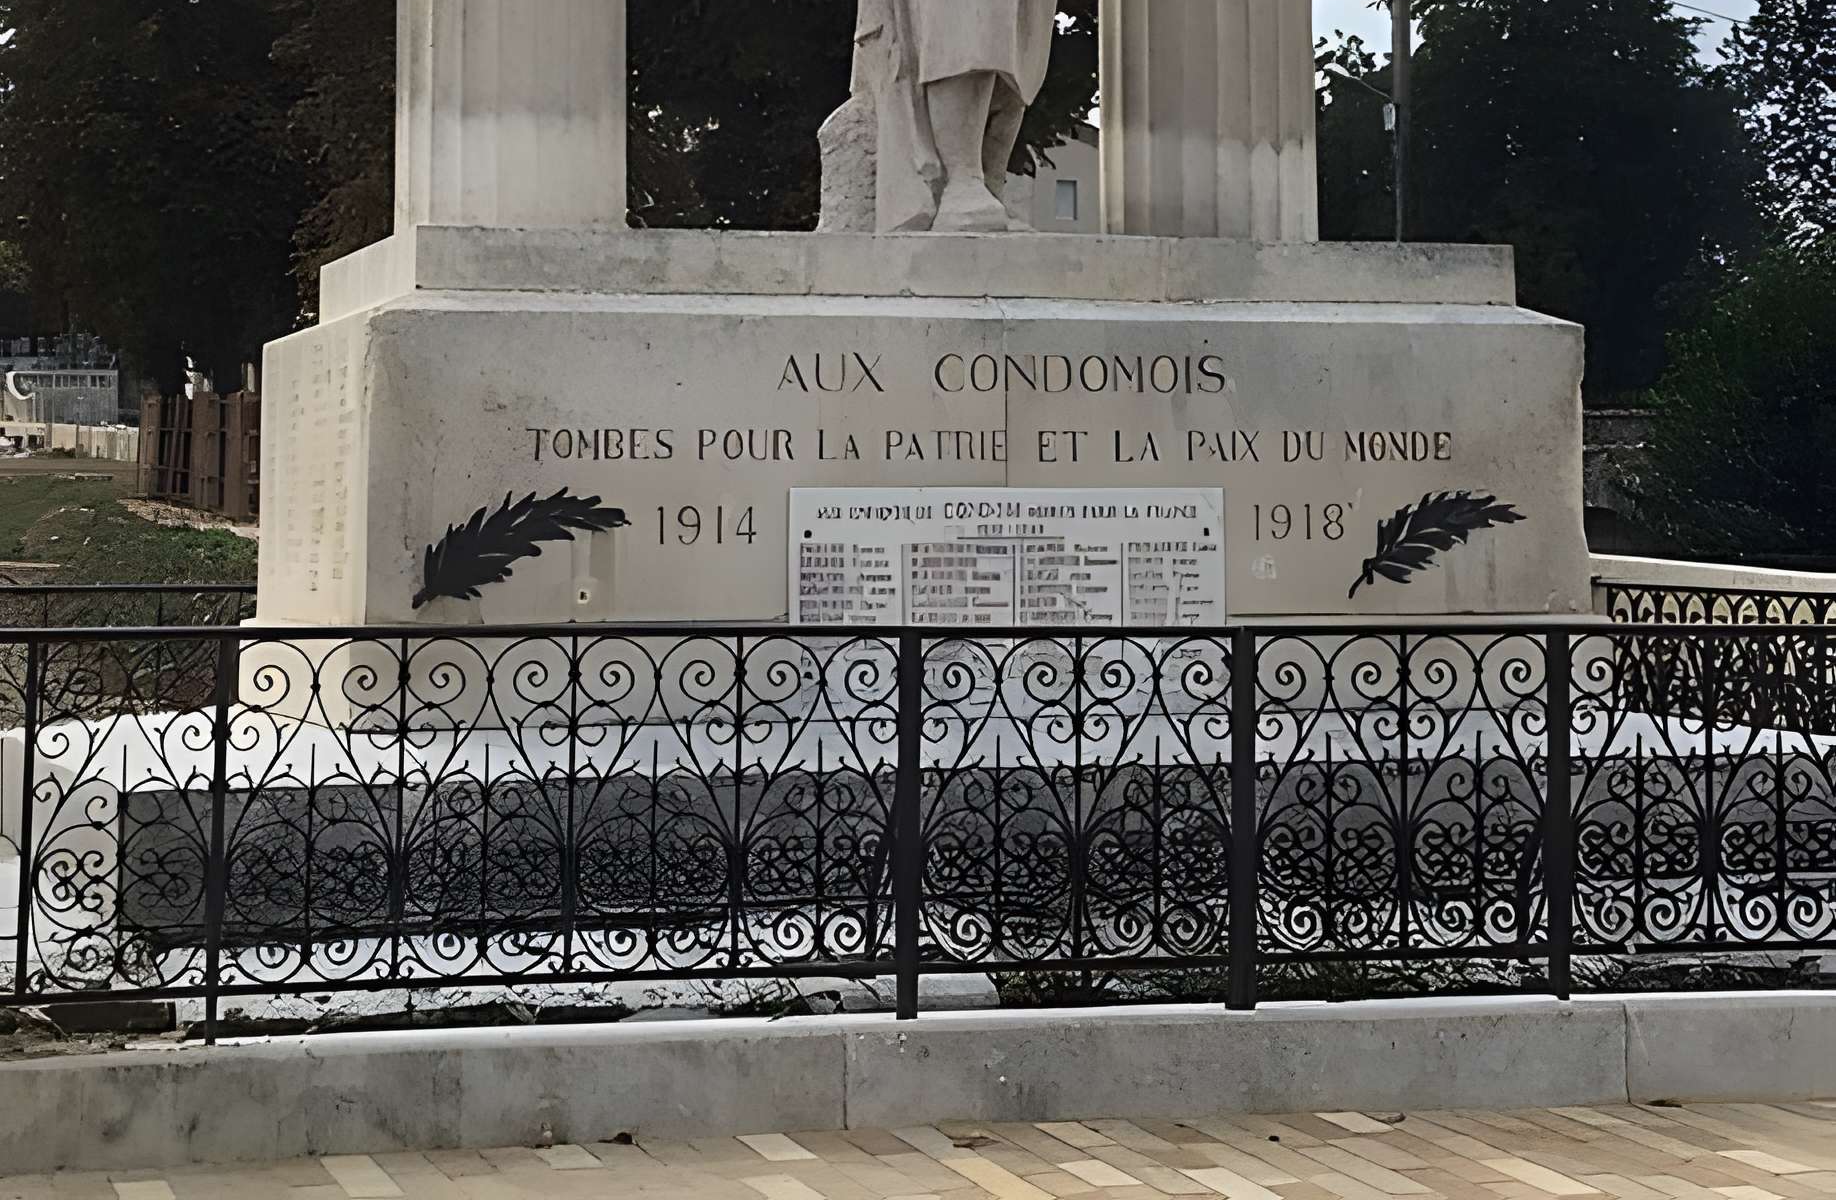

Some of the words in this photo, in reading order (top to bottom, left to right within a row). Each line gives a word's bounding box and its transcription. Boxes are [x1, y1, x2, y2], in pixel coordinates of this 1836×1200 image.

[778, 352, 885, 393] AUX
[935, 353, 1226, 393] CONDOMOIS
[525, 428, 675, 461] TOMBES
[699, 429, 795, 461] POUR
[818, 429, 861, 461] LA
[886, 429, 1008, 462] PATRIE
[1038, 431, 1089, 463] ET
[1114, 430, 1160, 463] LA
[1188, 430, 1260, 463] PAIX
[1283, 431, 1325, 463] DU
[1345, 431, 1452, 463] MONDE
[657, 505, 757, 546] 1914
[1253, 503, 1345, 542] 1918
